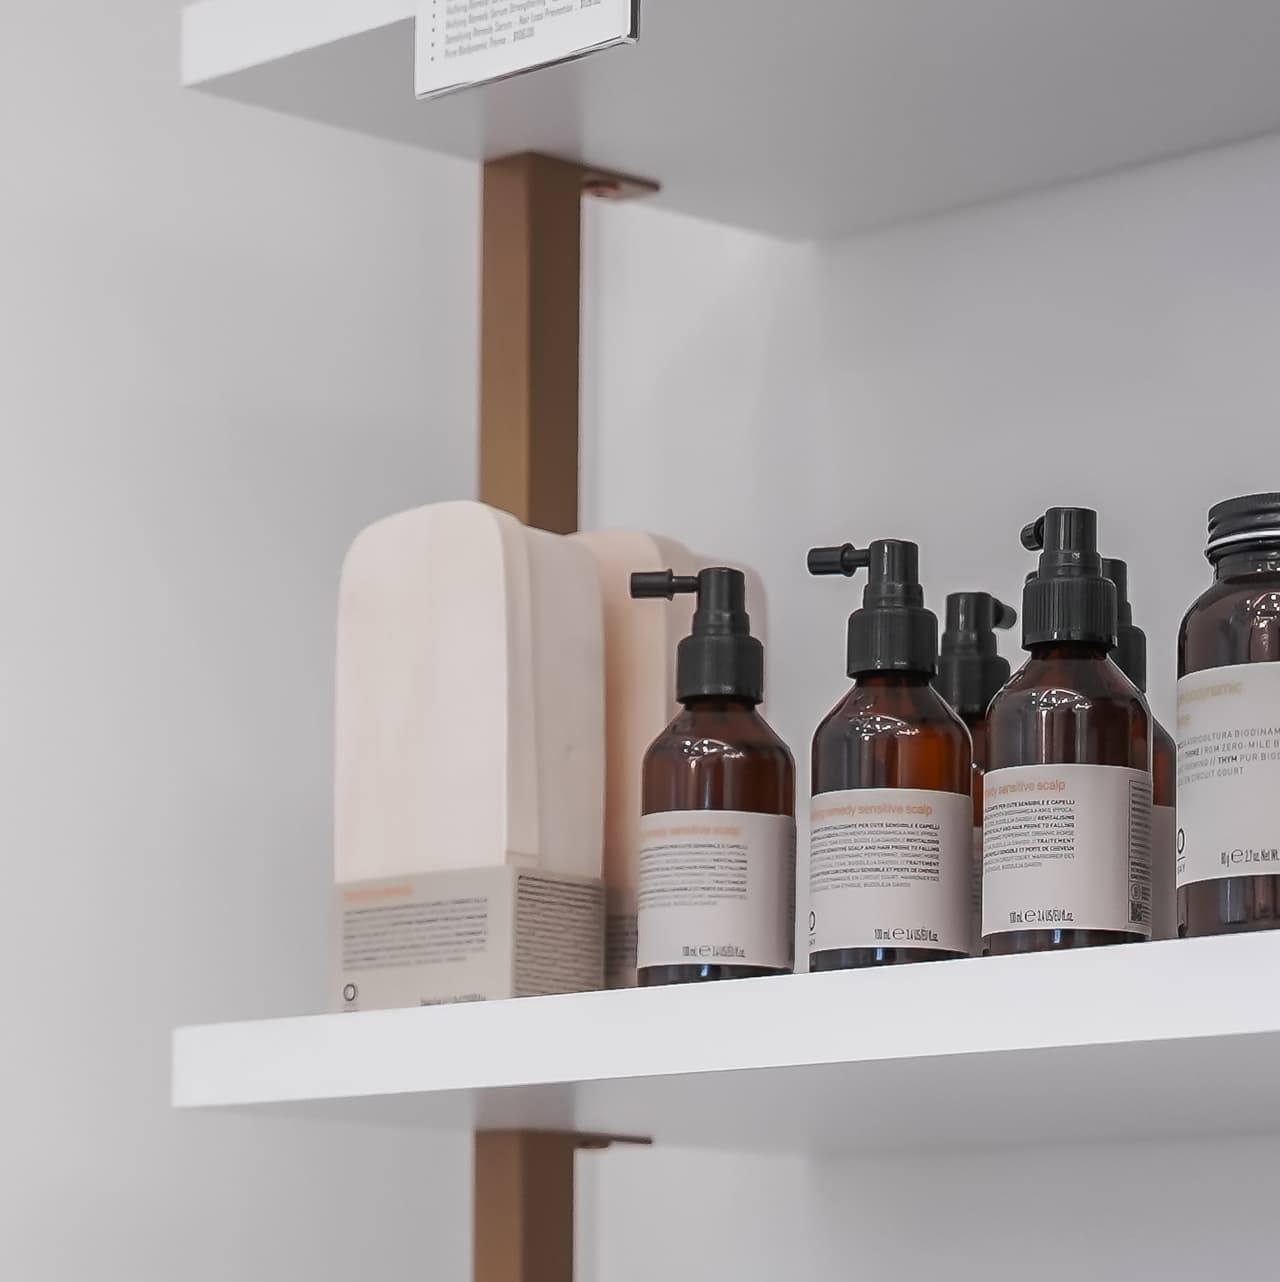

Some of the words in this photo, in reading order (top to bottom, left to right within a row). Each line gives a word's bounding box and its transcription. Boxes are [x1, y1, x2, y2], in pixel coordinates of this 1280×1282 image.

[1217, 755, 1238, 765] THYM
[1216, 766, 1244, 777] COURT
[1036, 779, 1066, 793] scalp
[905, 804, 933, 818] scalp
